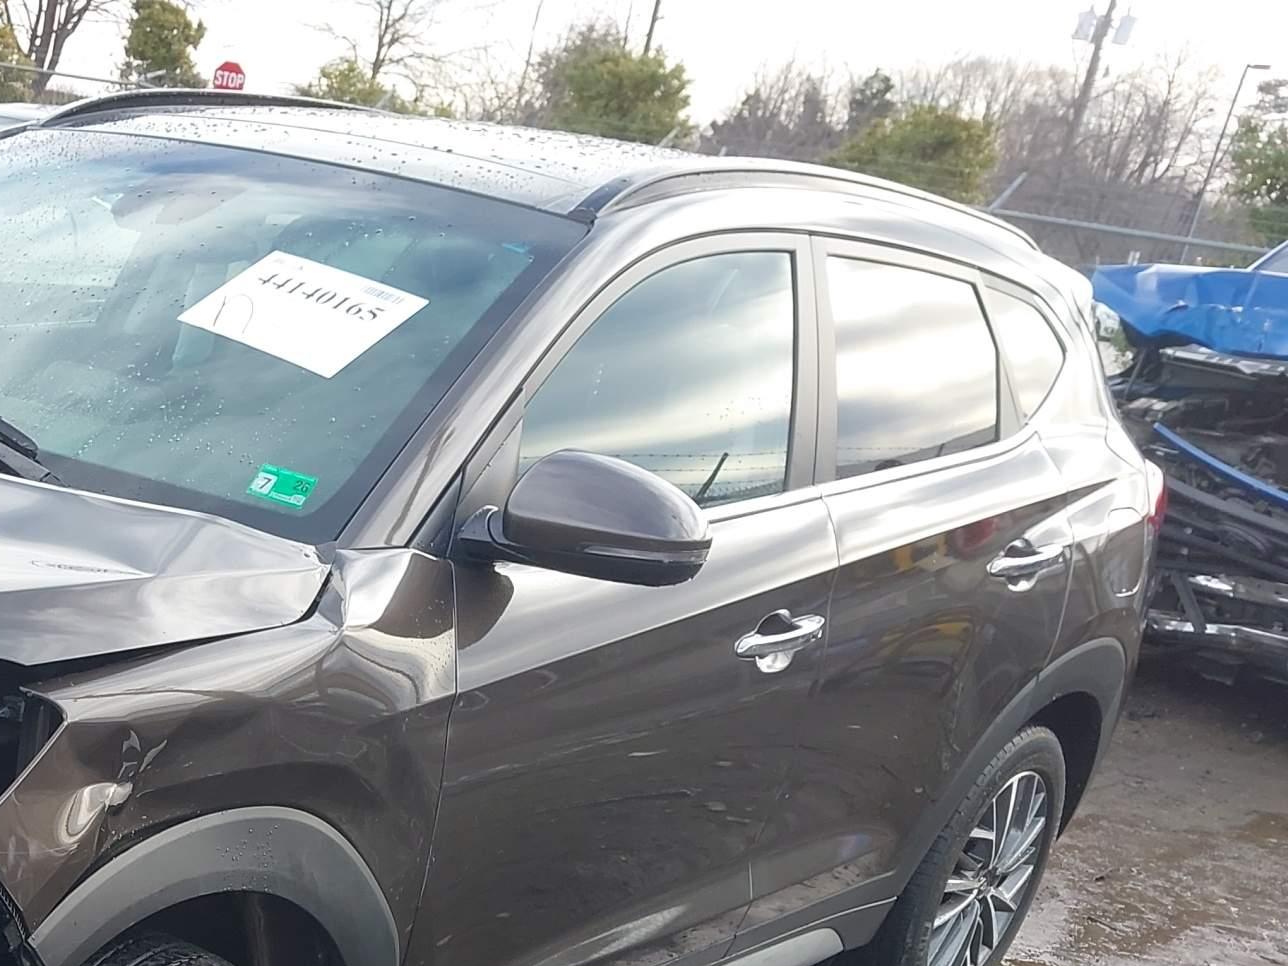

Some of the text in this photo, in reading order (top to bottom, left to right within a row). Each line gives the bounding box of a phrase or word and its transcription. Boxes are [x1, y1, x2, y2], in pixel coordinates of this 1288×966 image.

[215, 70, 244, 88] STOP
[259, 273, 385, 321] 44140165
[258, 476, 273, 490] 7
[293, 479, 311, 494] 26
